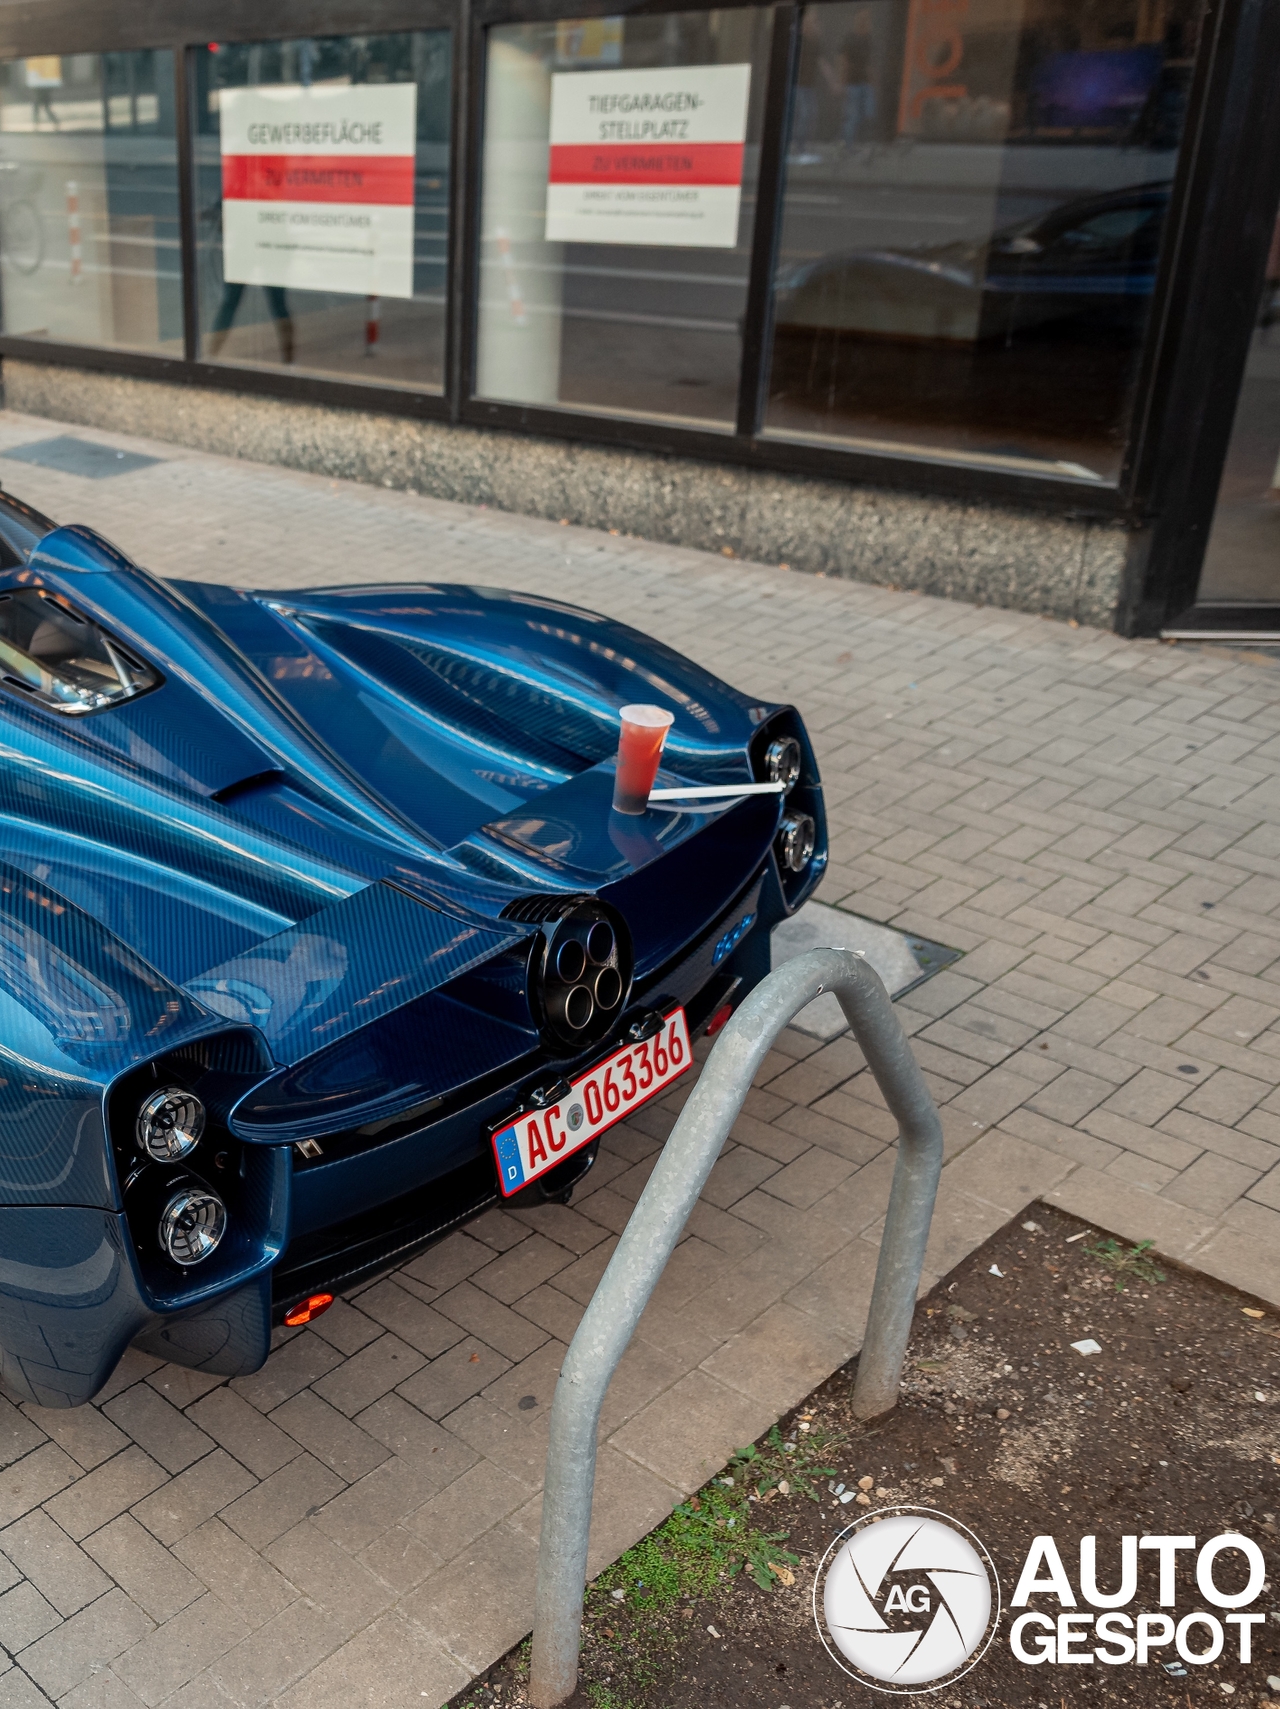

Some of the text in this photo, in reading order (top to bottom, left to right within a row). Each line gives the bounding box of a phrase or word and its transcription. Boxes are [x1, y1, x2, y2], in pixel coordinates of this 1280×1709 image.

[589, 91, 705, 113] TIEFGARAGEN-
[247, 119, 383, 144] GEWERBEFLÄCHE
[598, 119, 690, 140] STELLPLATZ
[614, 155, 693, 171] VERMIETEN
[286, 168, 363, 187] VERMIETEN
[527, 1021, 684, 1169] AC 063366
[507, 1165, 518, 1180] D
